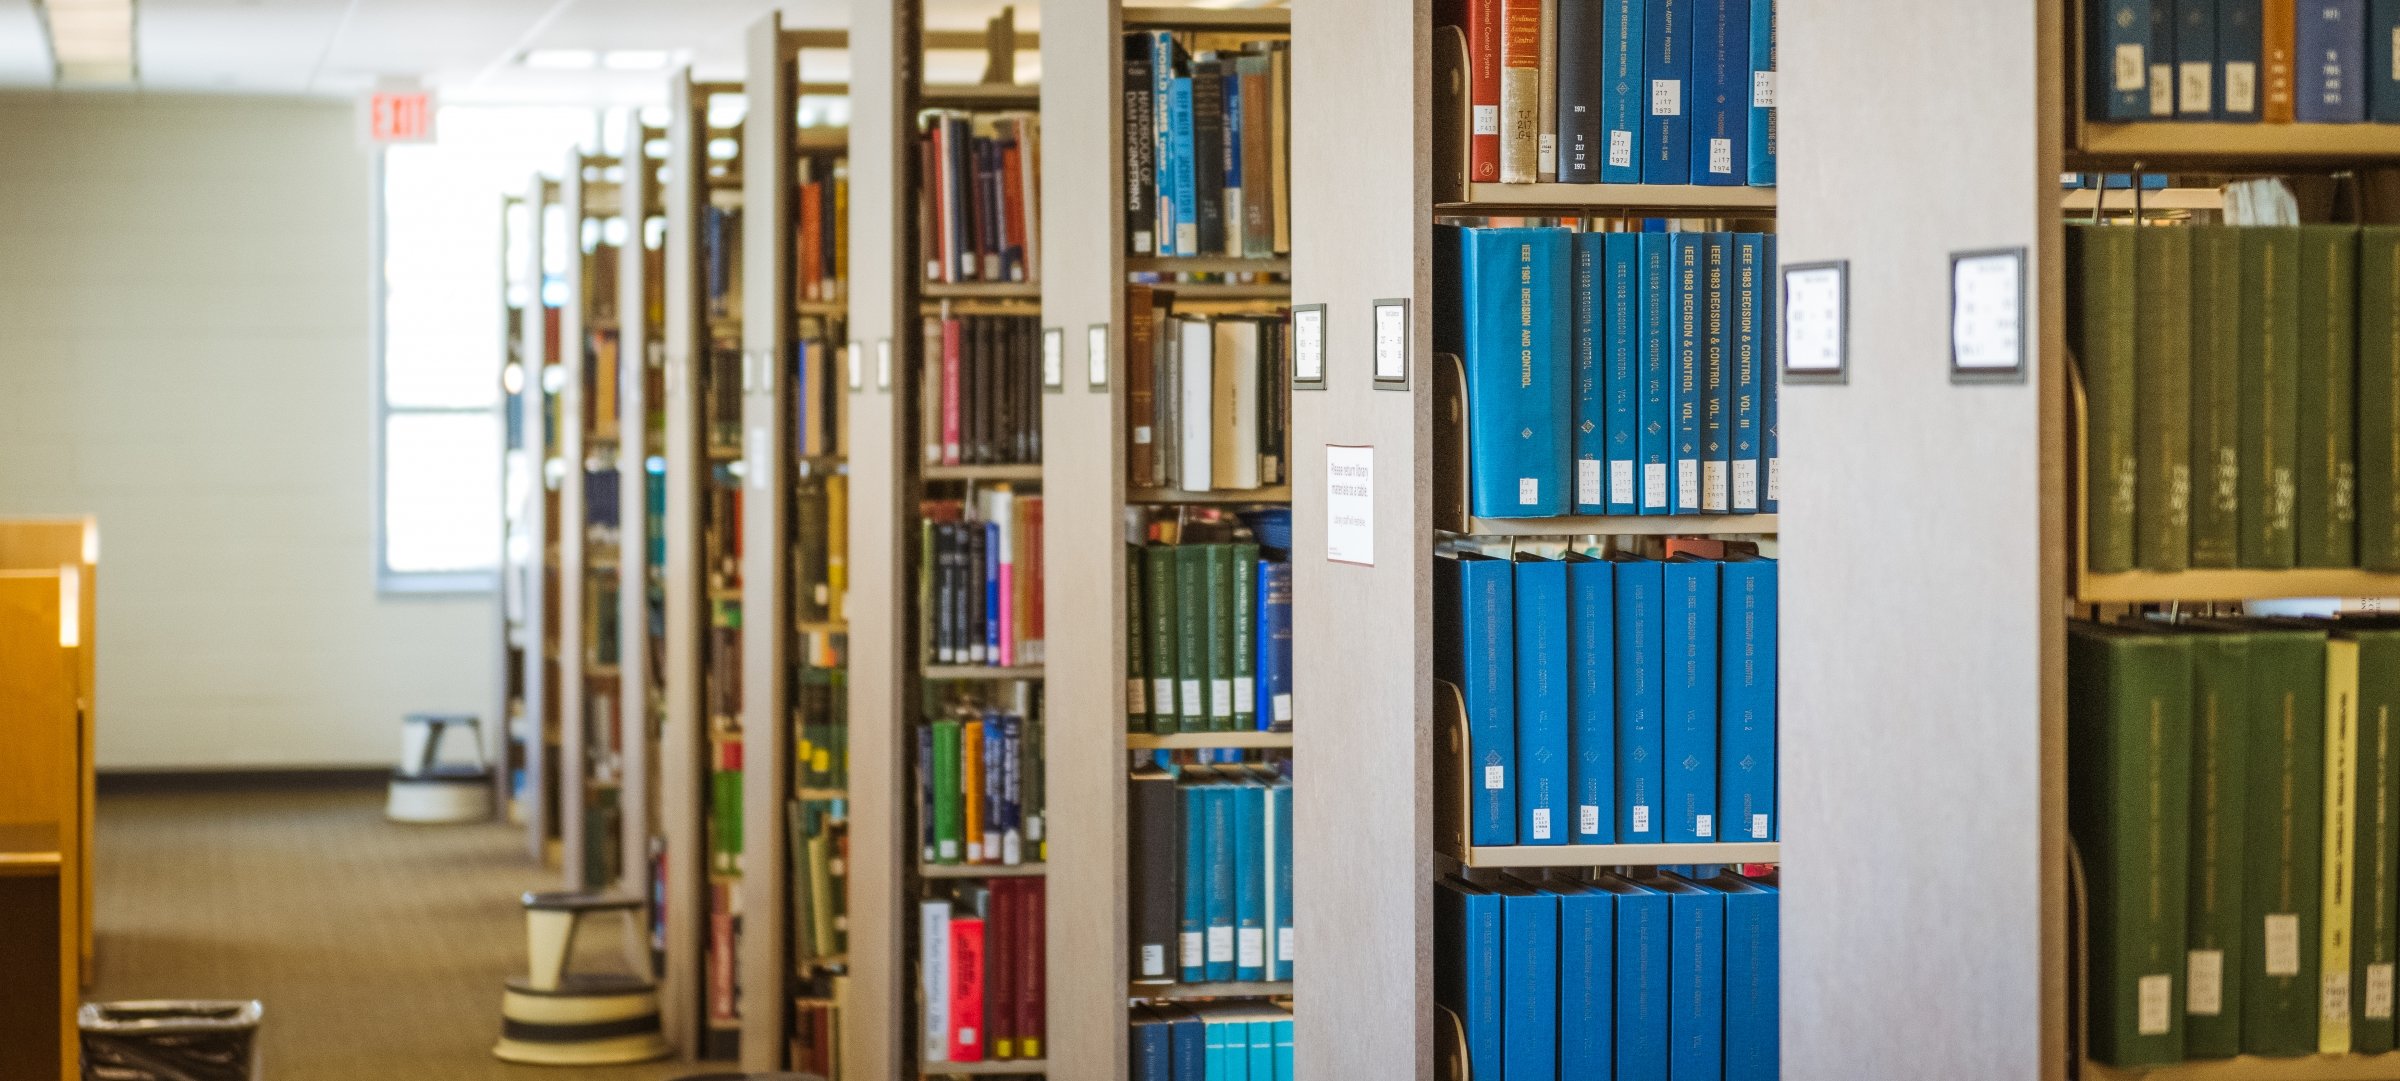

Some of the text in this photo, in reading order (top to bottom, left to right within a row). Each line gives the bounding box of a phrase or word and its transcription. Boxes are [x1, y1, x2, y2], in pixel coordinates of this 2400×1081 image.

[1484, 54, 1492, 79] Systems
[371, 94, 428, 139] EXIT
[1518, 121, 1531, 129] 217
[1519, 110, 1531, 118] TJ
[1138, 91, 1151, 166] HANDBOOK
[1127, 122, 1140, 210] ENGINEERING
[1582, 251, 1590, 266] IEEE
[1651, 253, 1659, 268] IEEE
[1684, 246, 1694, 266] IEEE
[1711, 245, 1720, 265] IEEE
[1743, 245, 1752, 265] IEEE
[1582, 270, 1591, 288] 1982
[1618, 262, 1626, 278] IEEE
[1684, 269, 1693, 290] 1983
[1711, 267, 1720, 288] 1983
[1742, 267, 1752, 288] 1983
[1522, 245, 1531, 388] IEEE 1981 DECISION AND CONTROL
[1583, 291, 1591, 324] DECISION
[1618, 302, 1626, 335] DECISION
[1651, 293, 1659, 326] DECISION
[1684, 293, 1693, 337] DECISION
[1711, 292, 1720, 334] DECISION
[1742, 290, 1751, 332] DECISION
[1583, 338, 1591, 370] CONTROL
[1618, 347, 1626, 380] CONTROL
[1651, 339, 1659, 371] CONTROL
[1683, 350, 1692, 393] CONTROL
[1710, 347, 1720, 390] CONTROL
[1741, 345, 1750, 387] CONTROL
[1683, 402, 1692, 424] VOL.
[1710, 398, 1719, 419] VOL.
[1741, 395, 1750, 416] VOL.
[1741, 419, 1750, 428] III
[1331, 463, 1343, 476] Please
